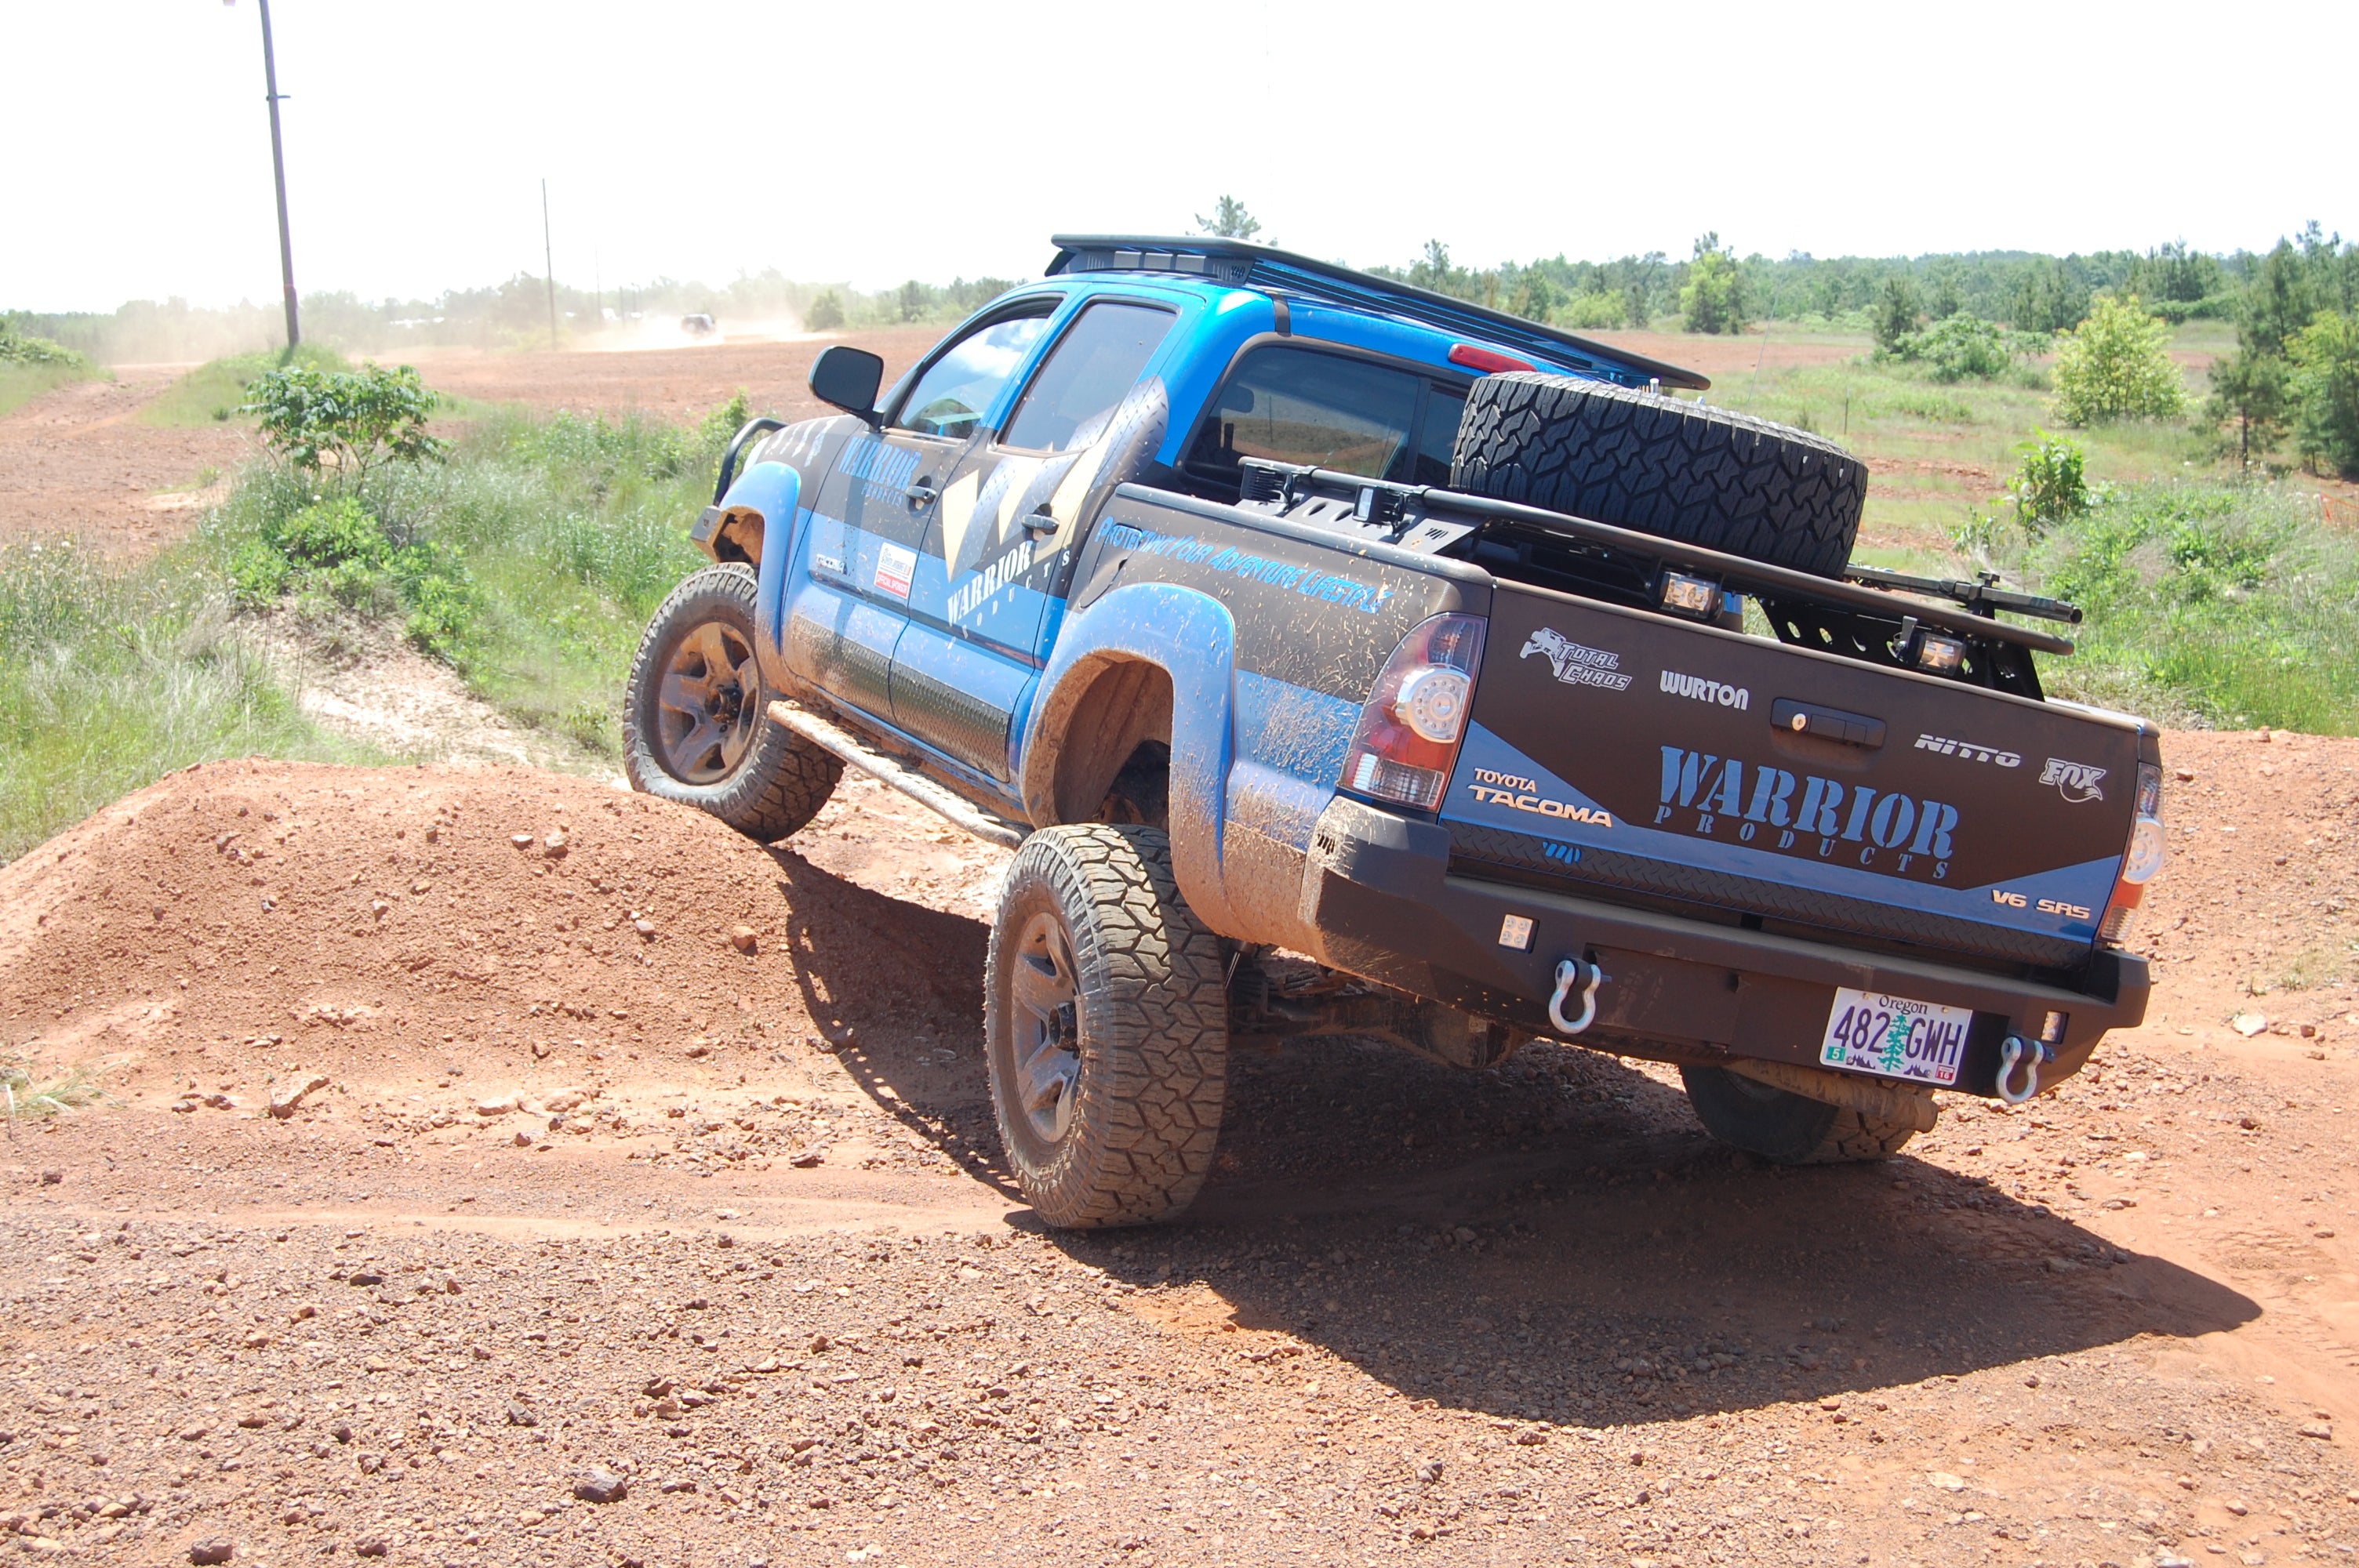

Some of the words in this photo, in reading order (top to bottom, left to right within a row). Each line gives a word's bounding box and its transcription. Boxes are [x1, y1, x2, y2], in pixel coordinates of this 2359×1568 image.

[838, 436, 922, 492] WARRIOR
[1166, 534, 1216, 564] YOUR
[1207, 546, 1307, 590] ADVENTURE
[947, 539, 1034, 627] WARRIOR
[1556, 641, 1618, 670] TOTAL
[1558, 662, 1632, 691] CHAOS
[1659, 670, 1749, 710] WURTON
[1914, 734, 2021, 768] NITTO
[1474, 768, 1536, 793] TOYOTA
[2041, 758, 2105, 790] FOX
[1468, 784, 1612, 828] TACOMA
[1660, 746, 1958, 859] WARRIOR
[1653, 804, 1949, 879] PRODUCTS
[1992, 889, 2027, 908] V6
[1878, 995, 1928, 1015] Oregon
[1834, 1005, 1891, 1054] 482
[1905, 1017, 1963, 1065] GWH
